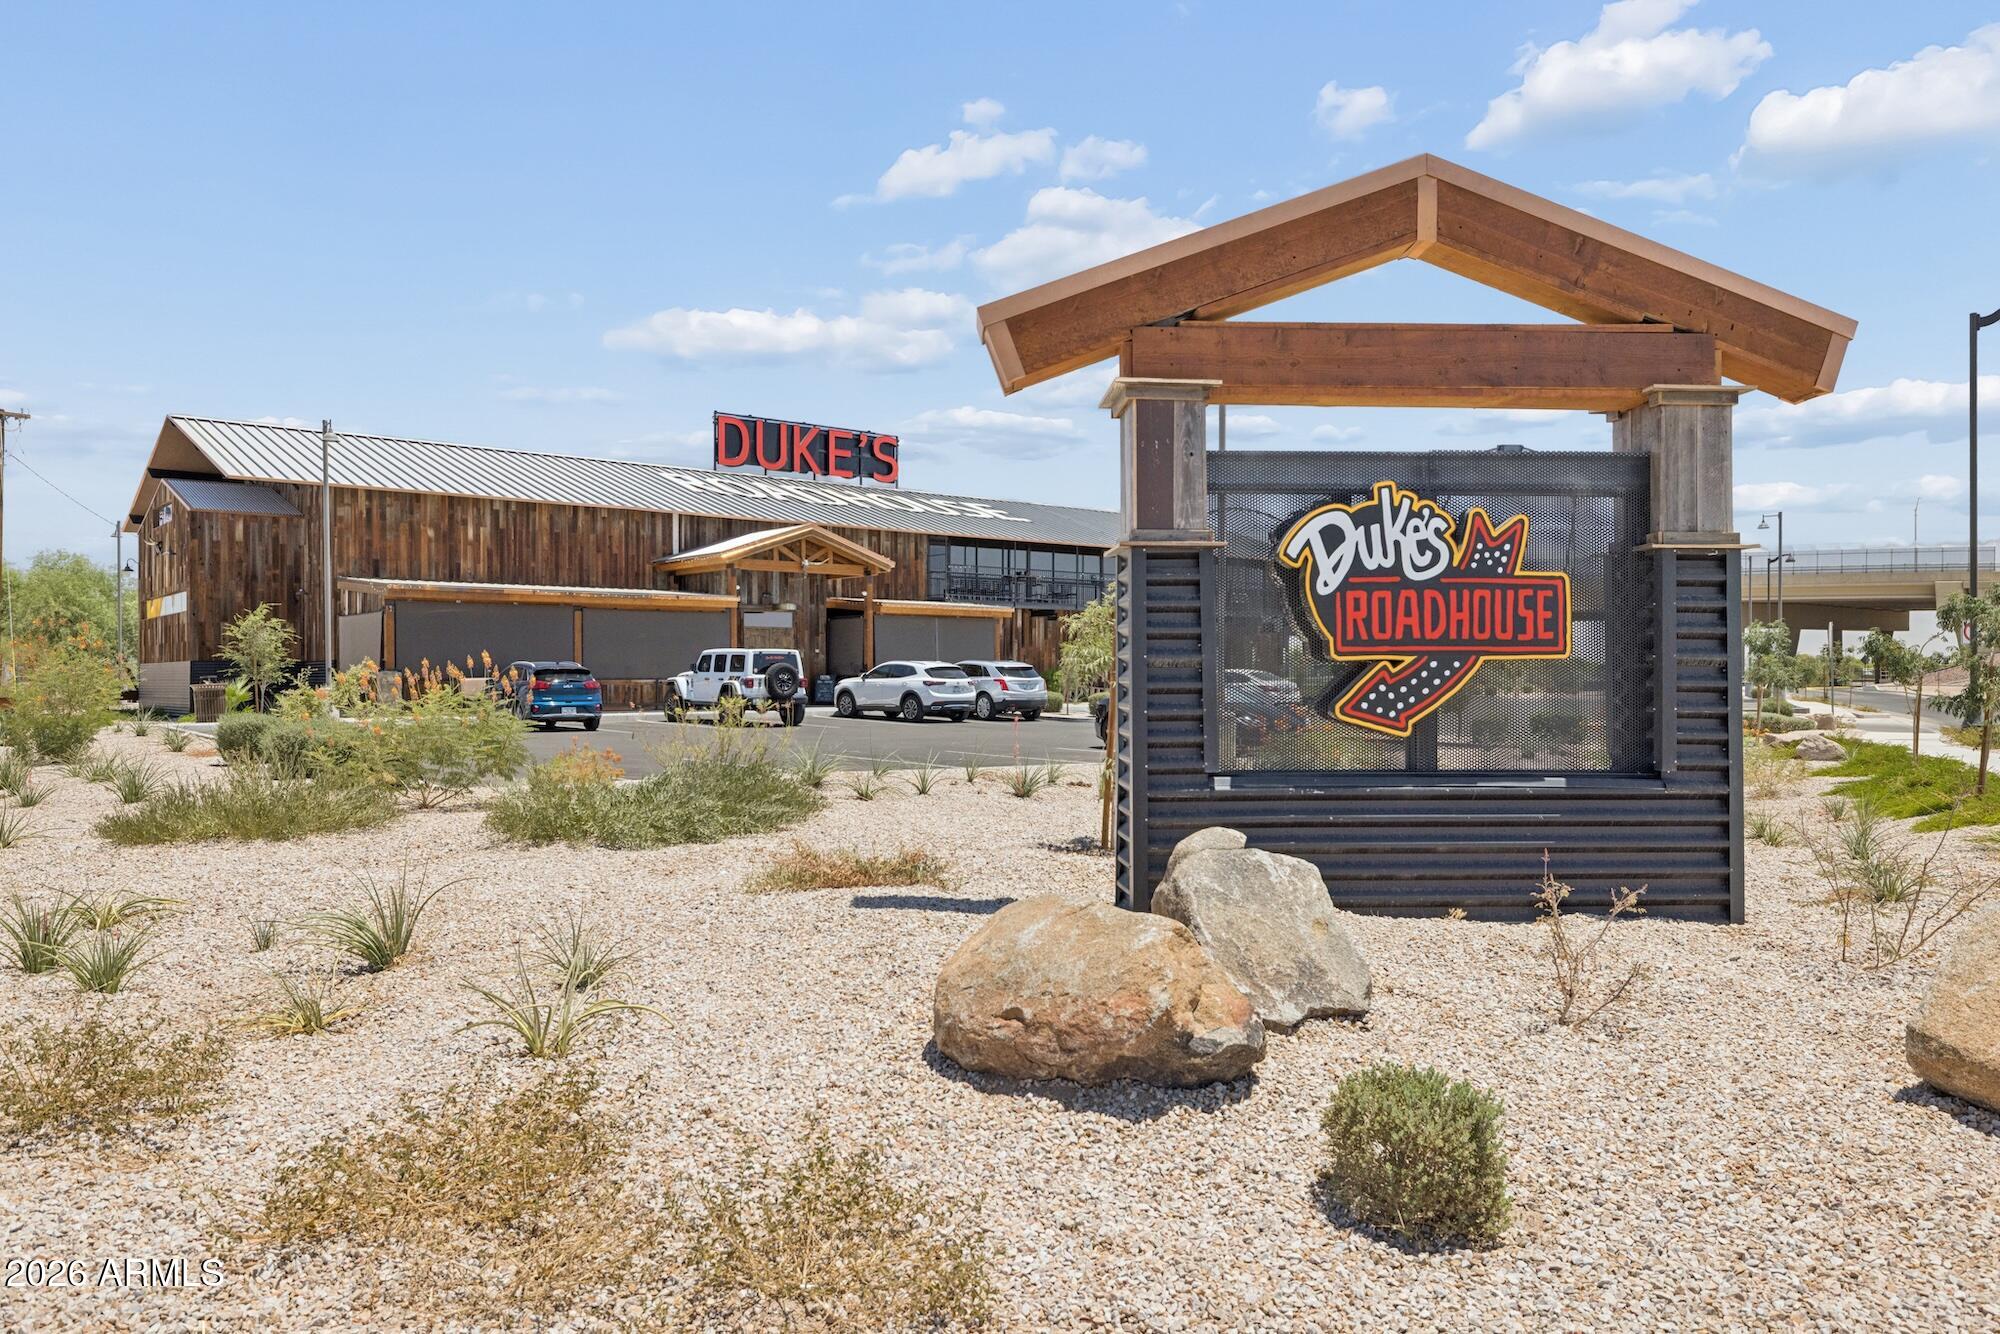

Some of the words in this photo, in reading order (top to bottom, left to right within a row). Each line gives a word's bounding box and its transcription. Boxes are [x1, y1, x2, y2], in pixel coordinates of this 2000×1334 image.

[717, 415, 899, 484] DUKE'S
[1286, 487, 1454, 596] Duke's
[1345, 588, 1554, 641] ROADHOUSE
